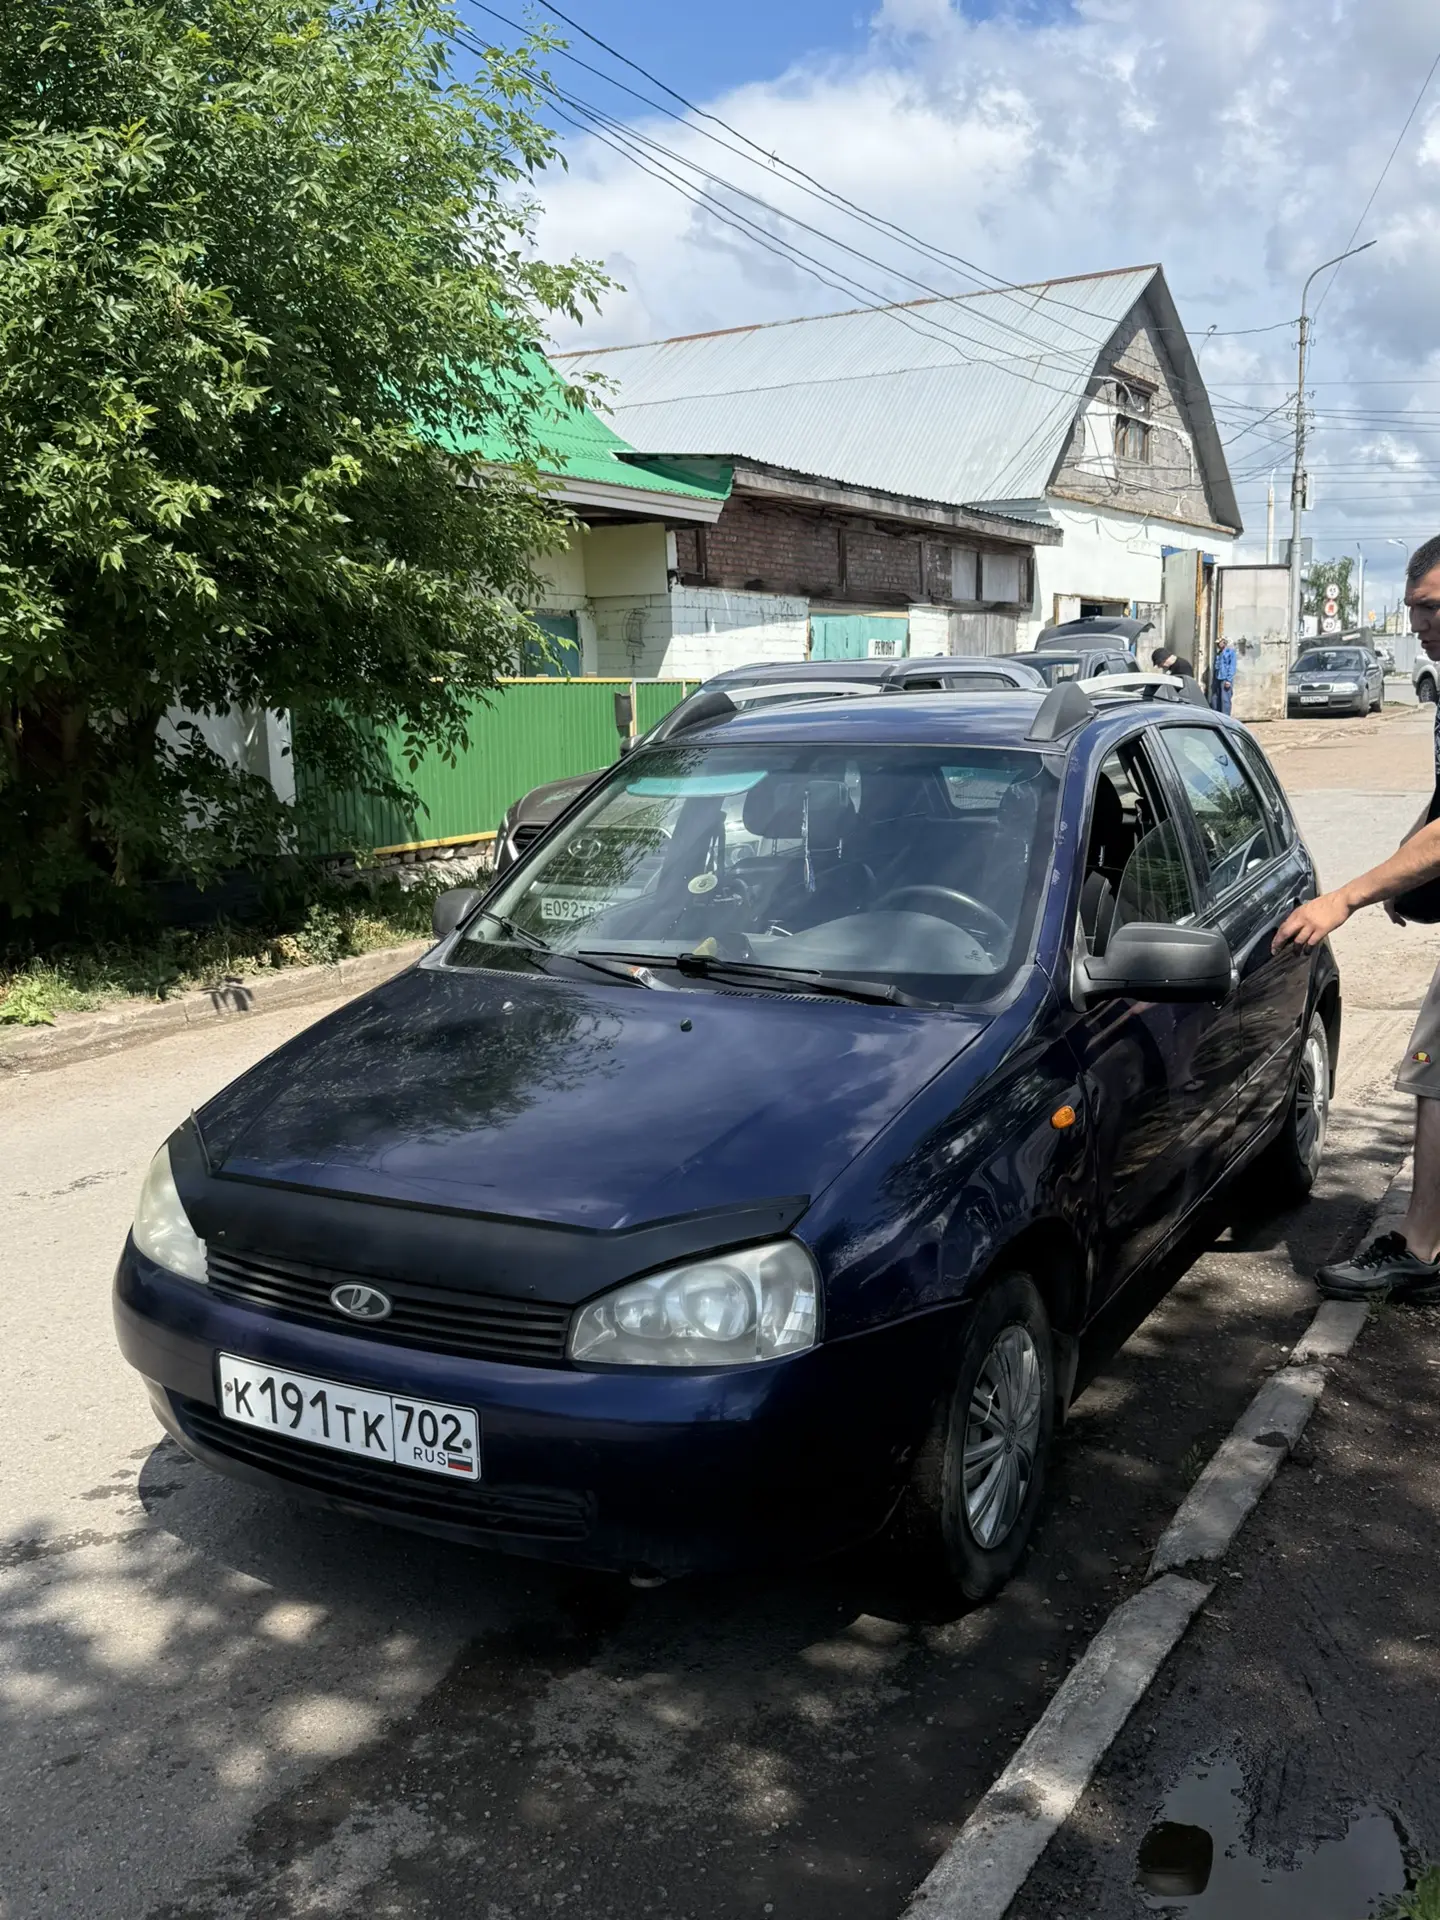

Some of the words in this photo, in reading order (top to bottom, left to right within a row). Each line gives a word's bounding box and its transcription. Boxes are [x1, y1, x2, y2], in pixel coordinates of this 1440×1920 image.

[234, 1377, 388, 1452] К191ТК
[395, 1404, 463, 1453] 702
[413, 1447, 447, 1466] RUS
